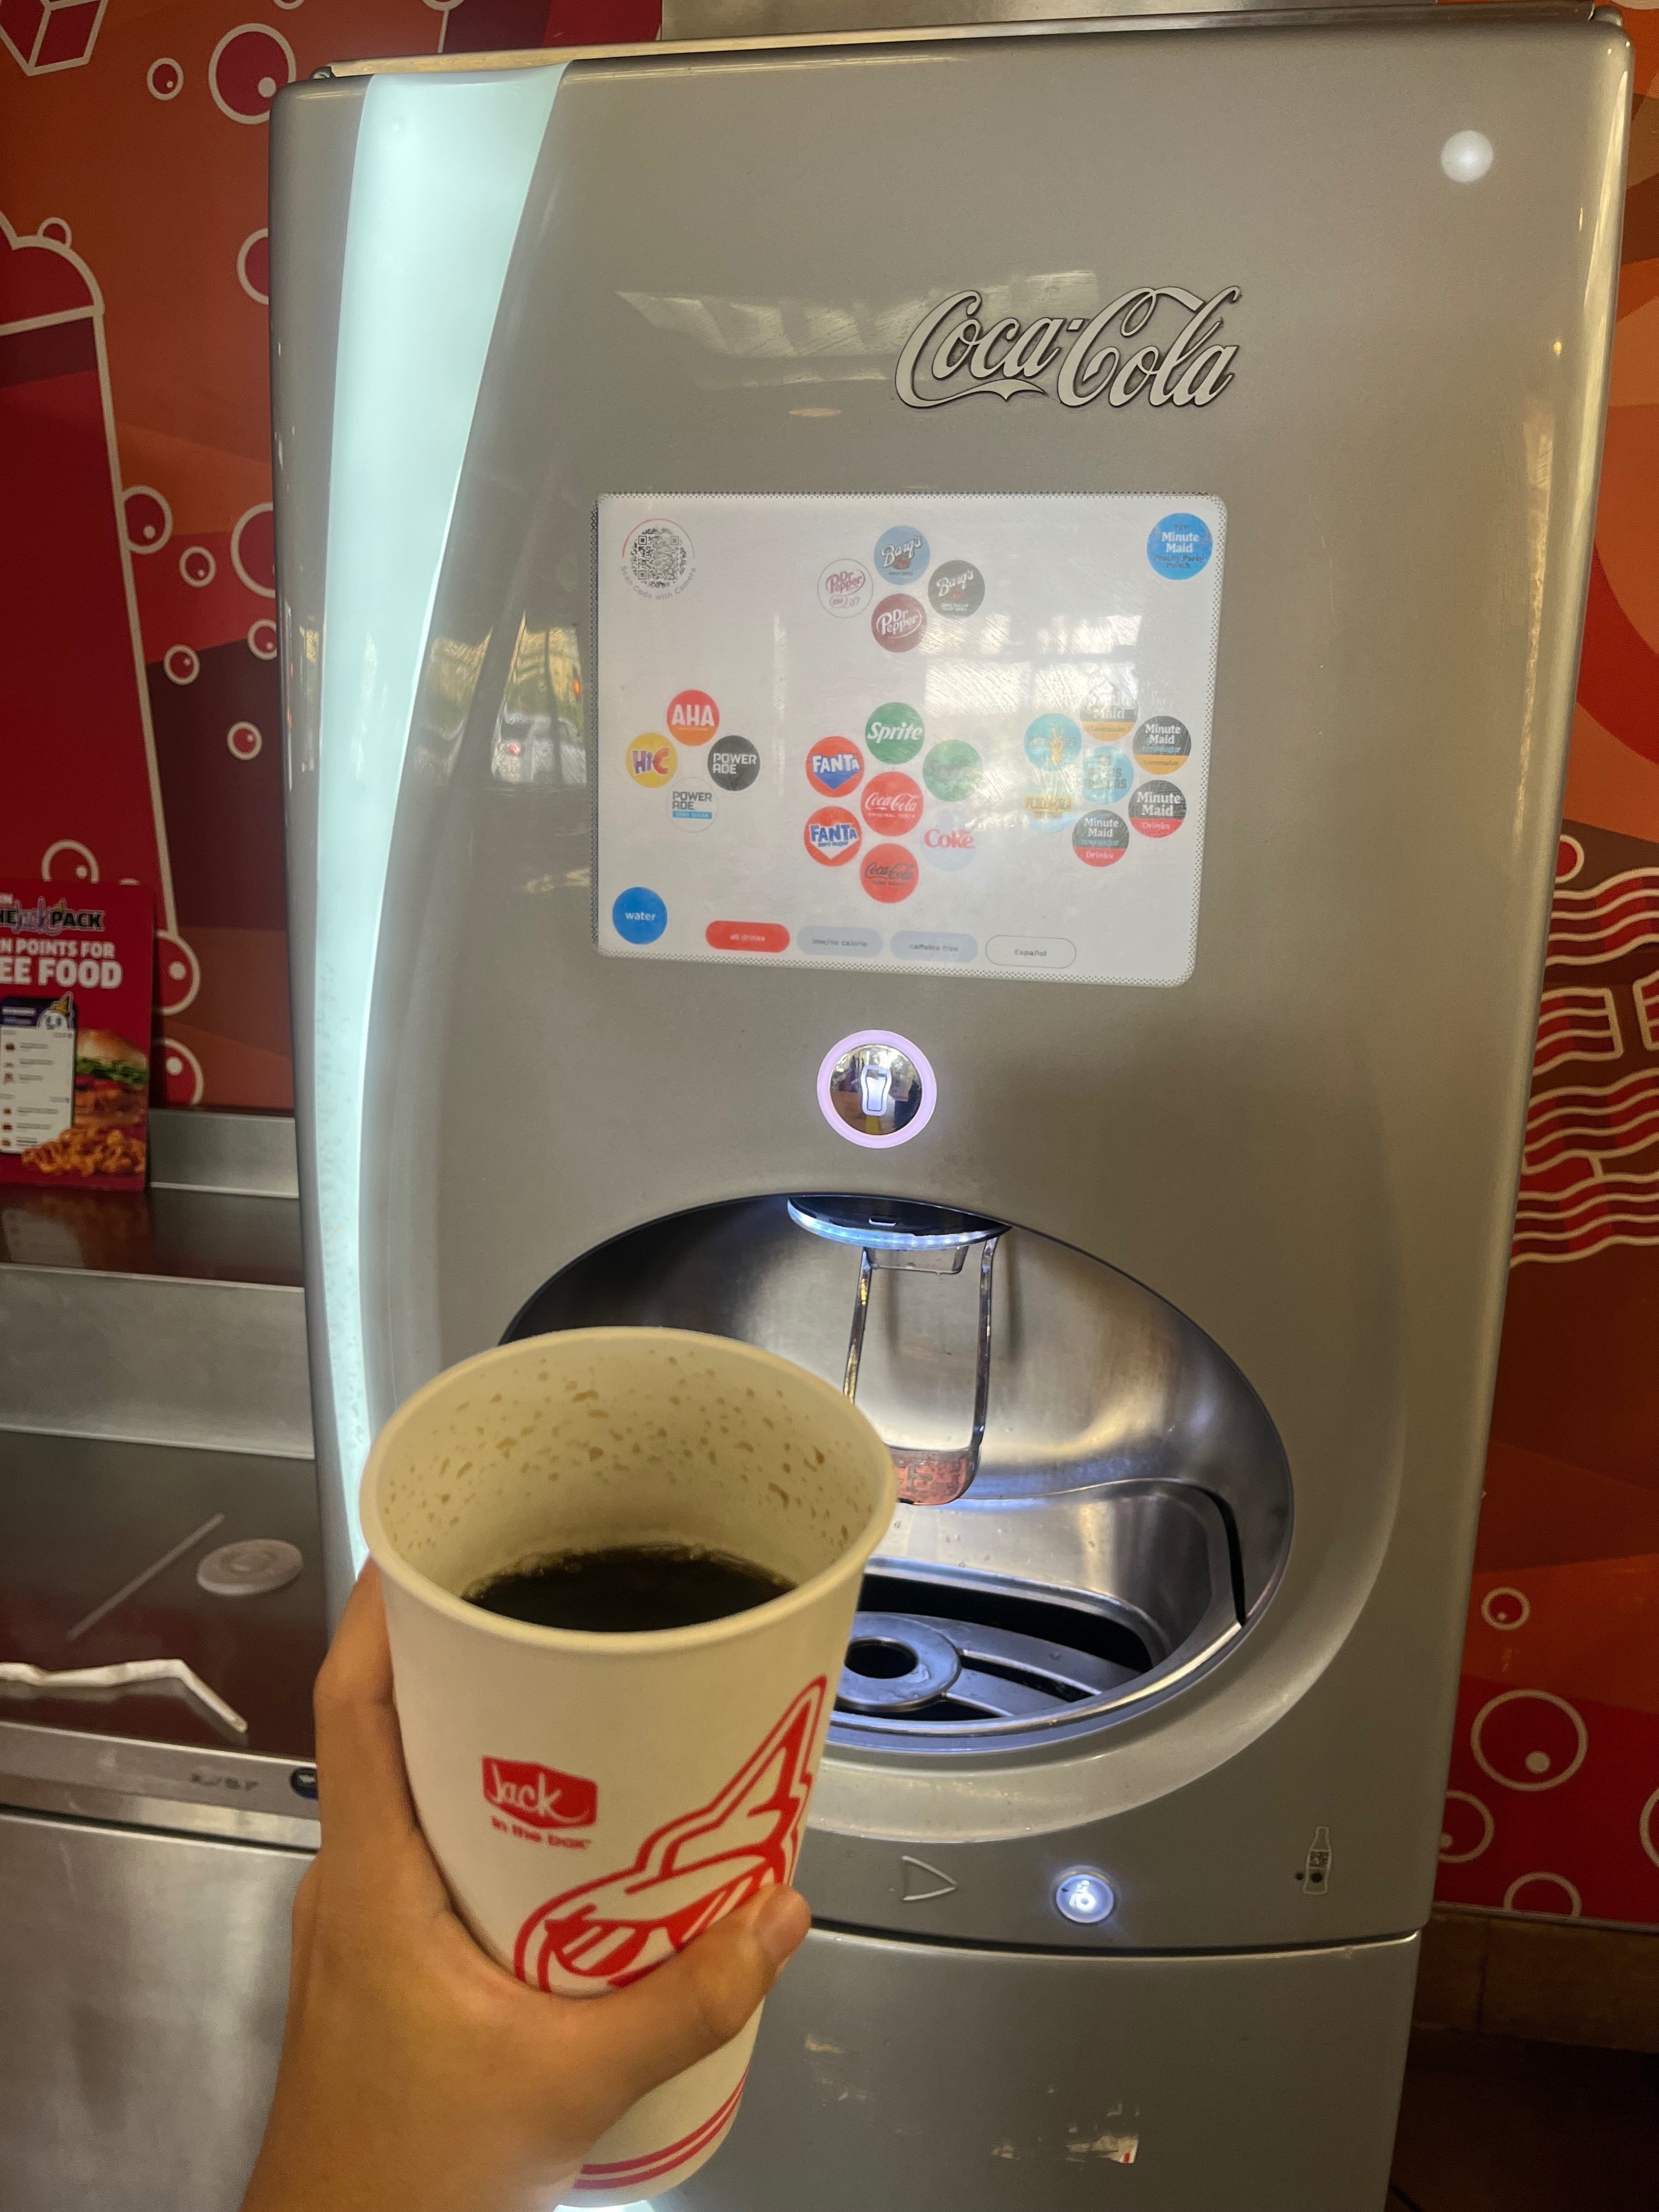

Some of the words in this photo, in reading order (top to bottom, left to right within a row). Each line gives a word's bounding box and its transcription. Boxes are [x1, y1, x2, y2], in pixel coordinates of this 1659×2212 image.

[895, 286, 1242, 409] Coca-Cola
[1161, 532, 1199, 542] Minute
[881, 535, 922, 568] Barq's
[1166, 543, 1193, 553] Maid
[621, 565, 633, 585] Scan
[633, 585, 653, 599] Code
[674, 567, 696, 594] Camera
[840, 571, 854, 582] Dr
[829, 574, 863, 594] Pepper
[936, 569, 974, 597] Barq's
[893, 609, 909, 622] Dr
[879, 612, 919, 635] Pepper
[672, 704, 715, 726] AHA
[1093, 707, 1125, 719] Maid
[867, 722, 923, 743] Sprite
[1145, 724, 1181, 734] Minute
[1149, 735, 1175, 744] Maid
[713, 753, 757, 765] POWER
[811, 754, 860, 773] FANTA
[713, 764, 737, 774] ADE
[673, 791, 712, 802] POWER
[865, 792, 918, 812] Coca-Cola
[1137, 792, 1181, 804] Minute
[673, 801, 695, 810] ADE
[1142, 804, 1173, 816] Maid
[1084, 818, 1119, 827] Minute
[1142, 822, 1170, 830] Drinks
[810, 825, 857, 842] FANTA
[1088, 827, 1113, 837] Maid
[924, 829, 976, 849] Coke
[1086, 851, 1114, 859] Drinks
[51, 911, 102, 928] PACK
[625, 911, 656, 921] water
[15, 938, 78, 957] POINTS
[80, 940, 116, 958] FOR
[1014, 949, 1047, 957] Español
[38, 956, 123, 989] FOOD
[487, 1762, 591, 1823] Jack
